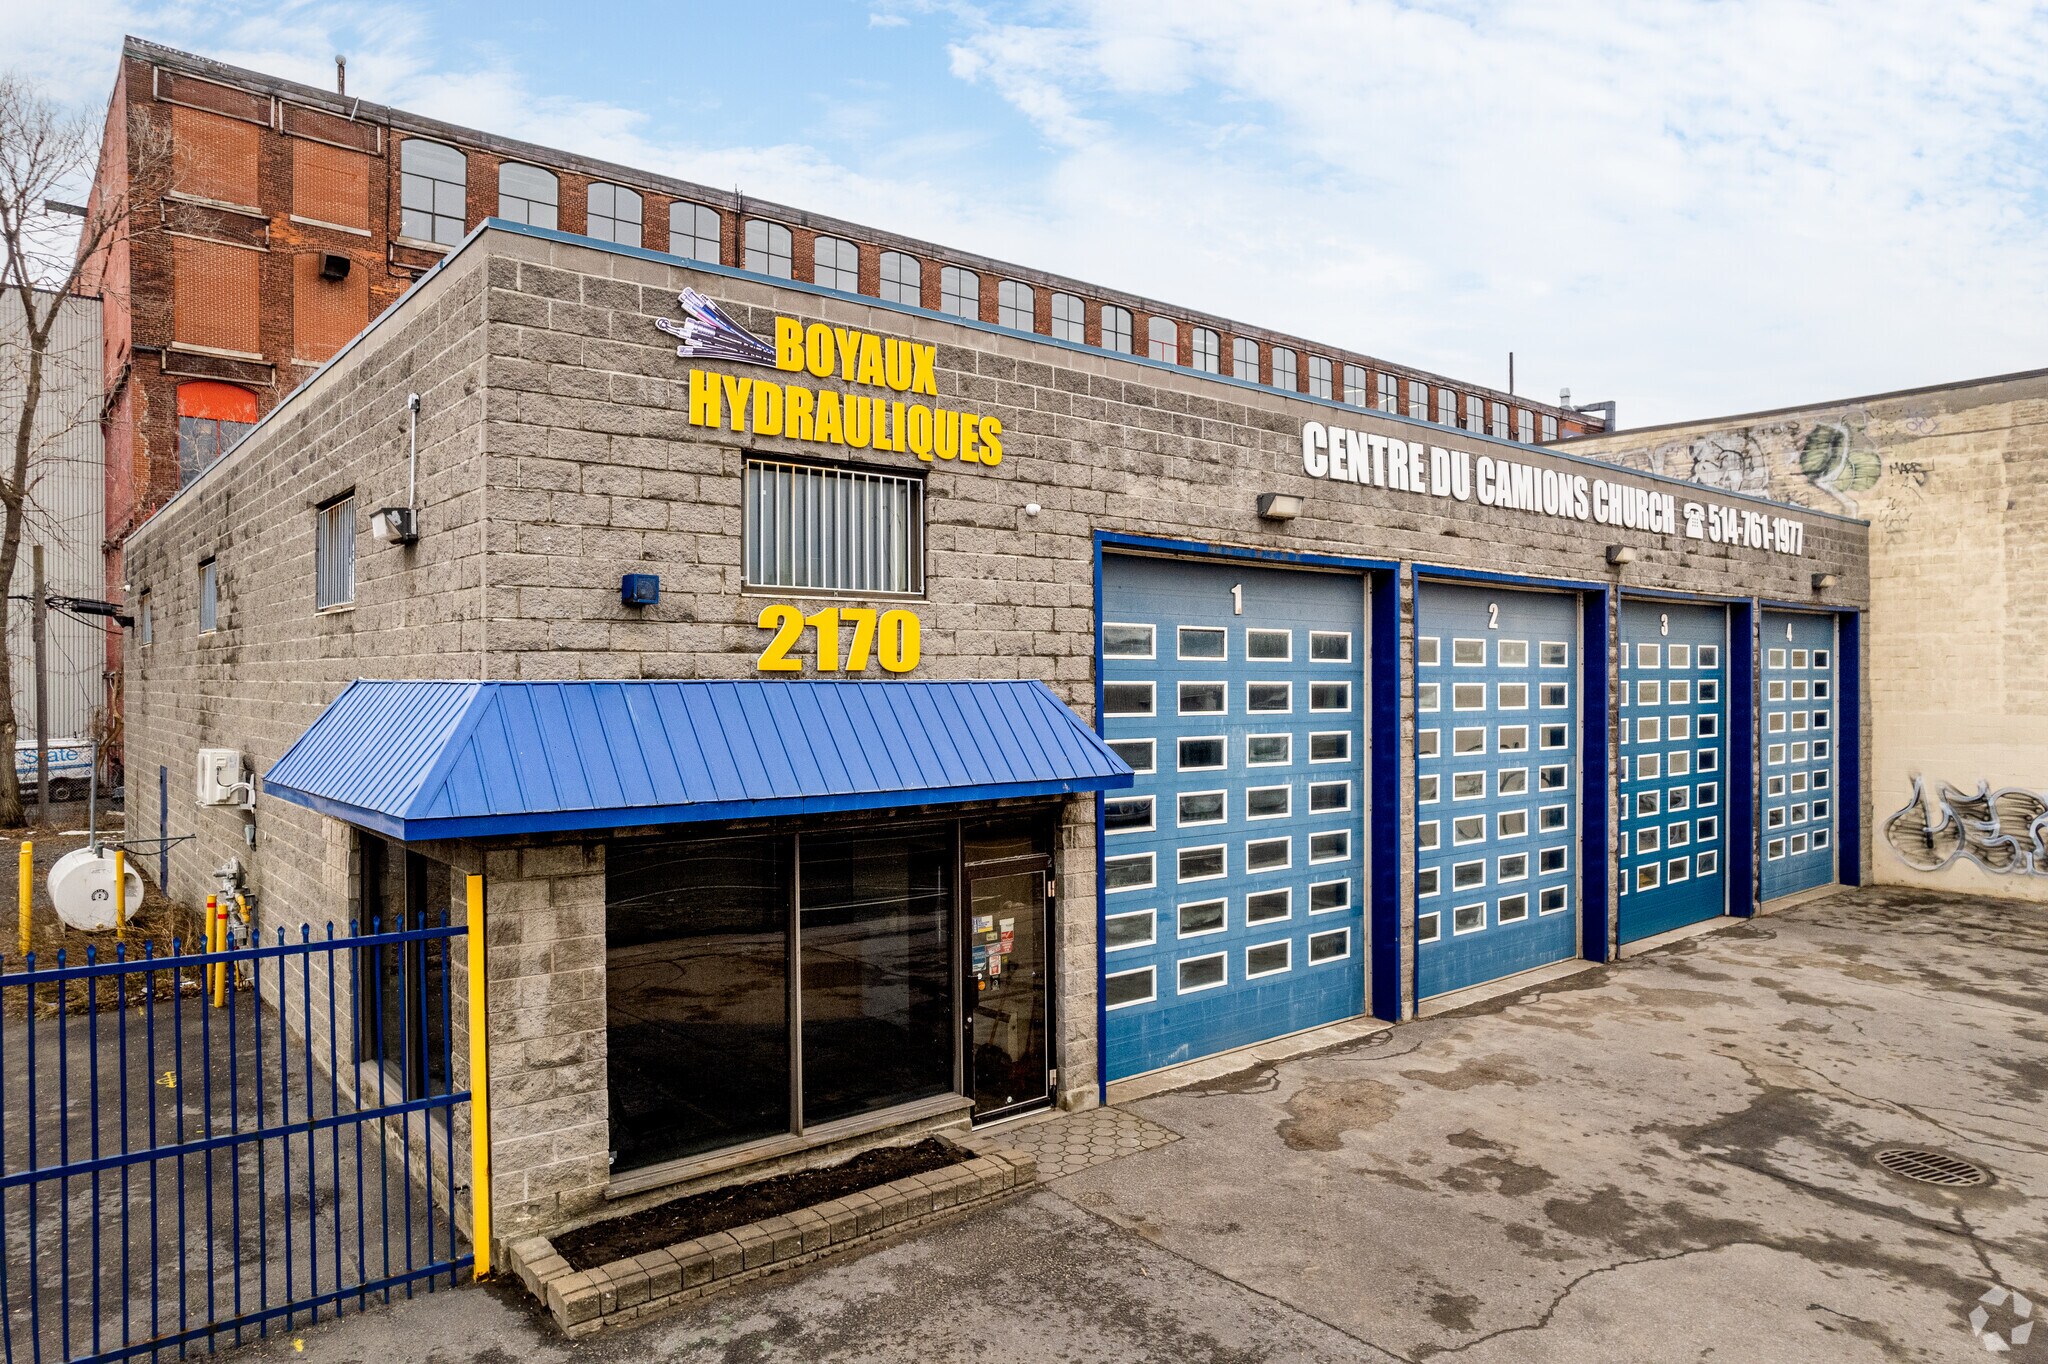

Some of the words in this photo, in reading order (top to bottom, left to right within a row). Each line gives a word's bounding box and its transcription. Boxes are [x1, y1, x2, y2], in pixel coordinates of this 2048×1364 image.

[774, 316, 938, 396] BOYAUX
[689, 369, 1003, 466] HYDRAULIQUES
[1302, 421, 1426, 494] CENTRE
[1430, 446, 1471, 501] DU
[1476, 456, 1590, 521] CAMIONS
[1592, 479, 1676, 535] CHURCH
[1708, 503, 1804, 556] 514-761-1977
[1231, 584, 1242, 615] 1
[1488, 603, 1499, 629] 2
[1660, 613, 1669, 636] 3
[757, 604, 921, 673] 2170
[1786, 623, 1793, 642] 4
[23, 748, 79, 764] Sate
